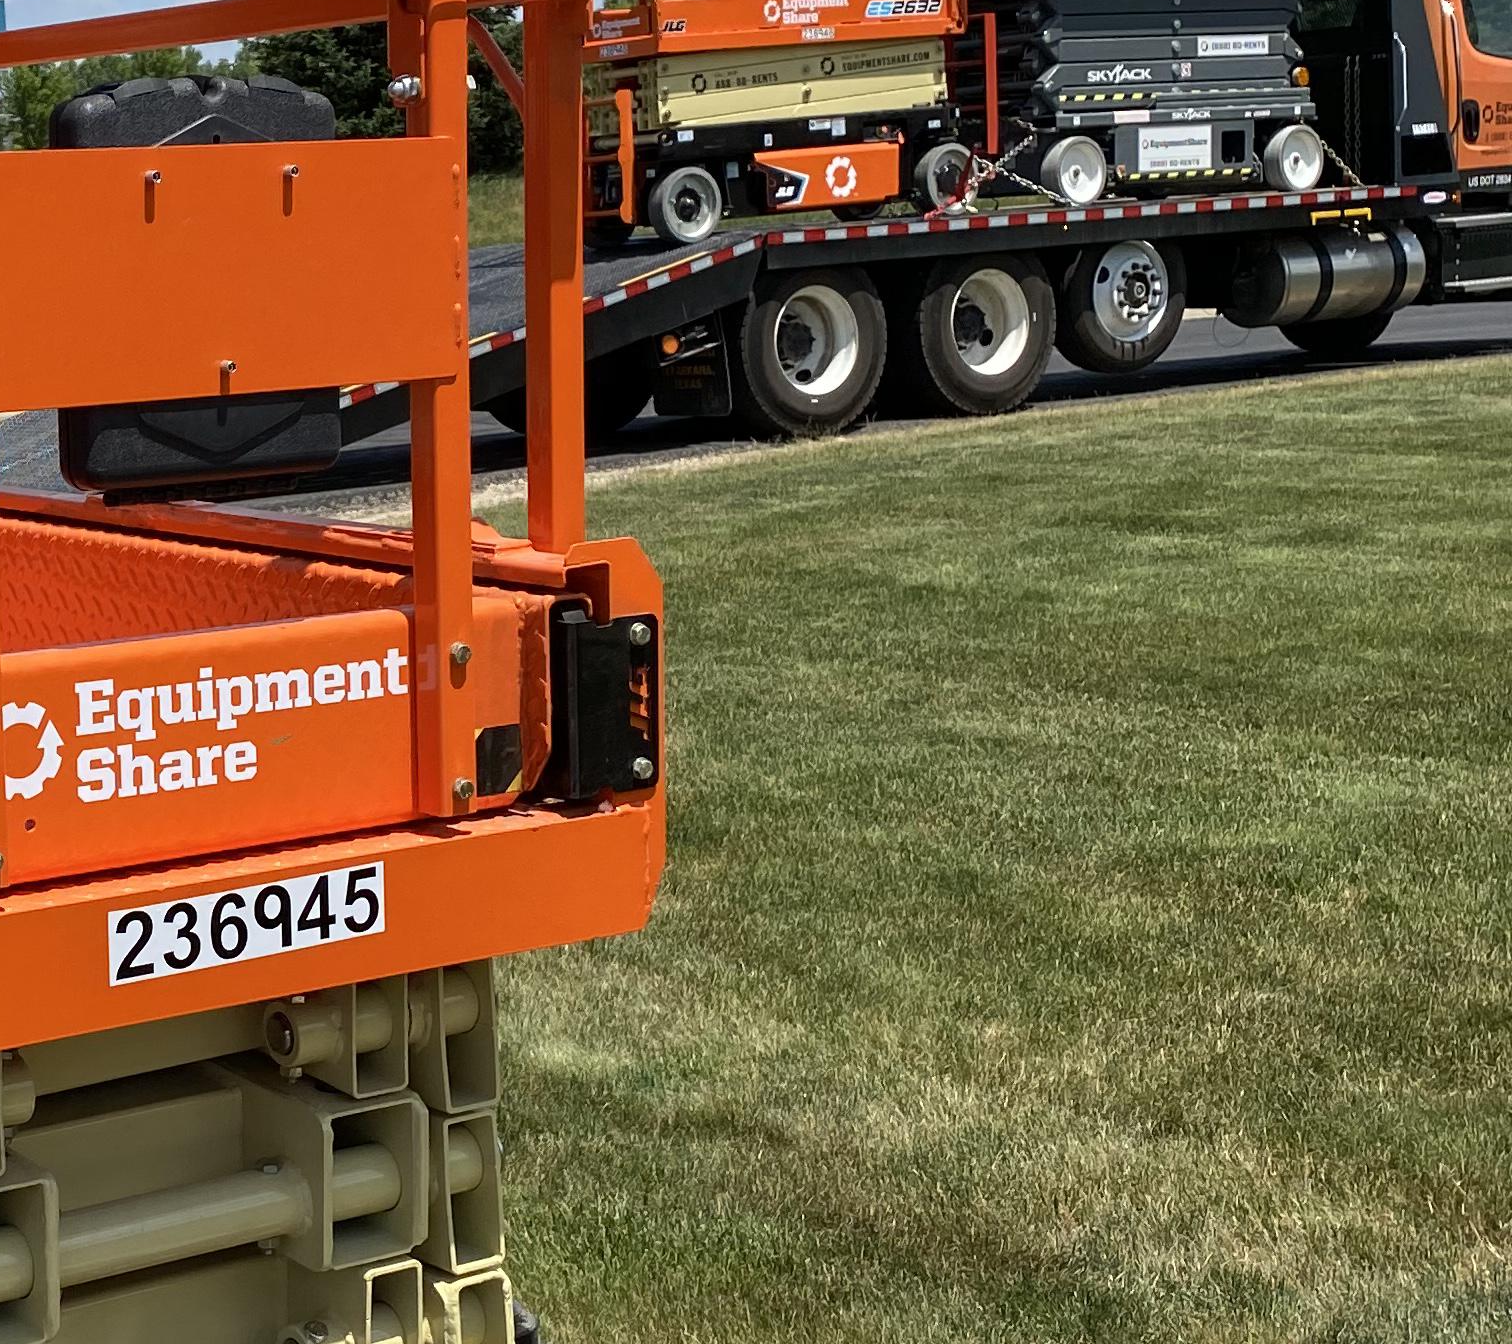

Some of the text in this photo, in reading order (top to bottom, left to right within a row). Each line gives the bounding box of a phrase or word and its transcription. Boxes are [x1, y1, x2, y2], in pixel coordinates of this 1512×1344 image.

[660, 20, 686, 32] JLG
[783, 11, 819, 24] Share
[1088, 64, 1152, 83] SKYJACK
[1468, 176, 1478, 187] US
[1480, 174, 1494, 185] DOT
[76, 646, 407, 730] Equipment
[76, 738, 258, 803] Share
[114, 864, 381, 983] 236945
